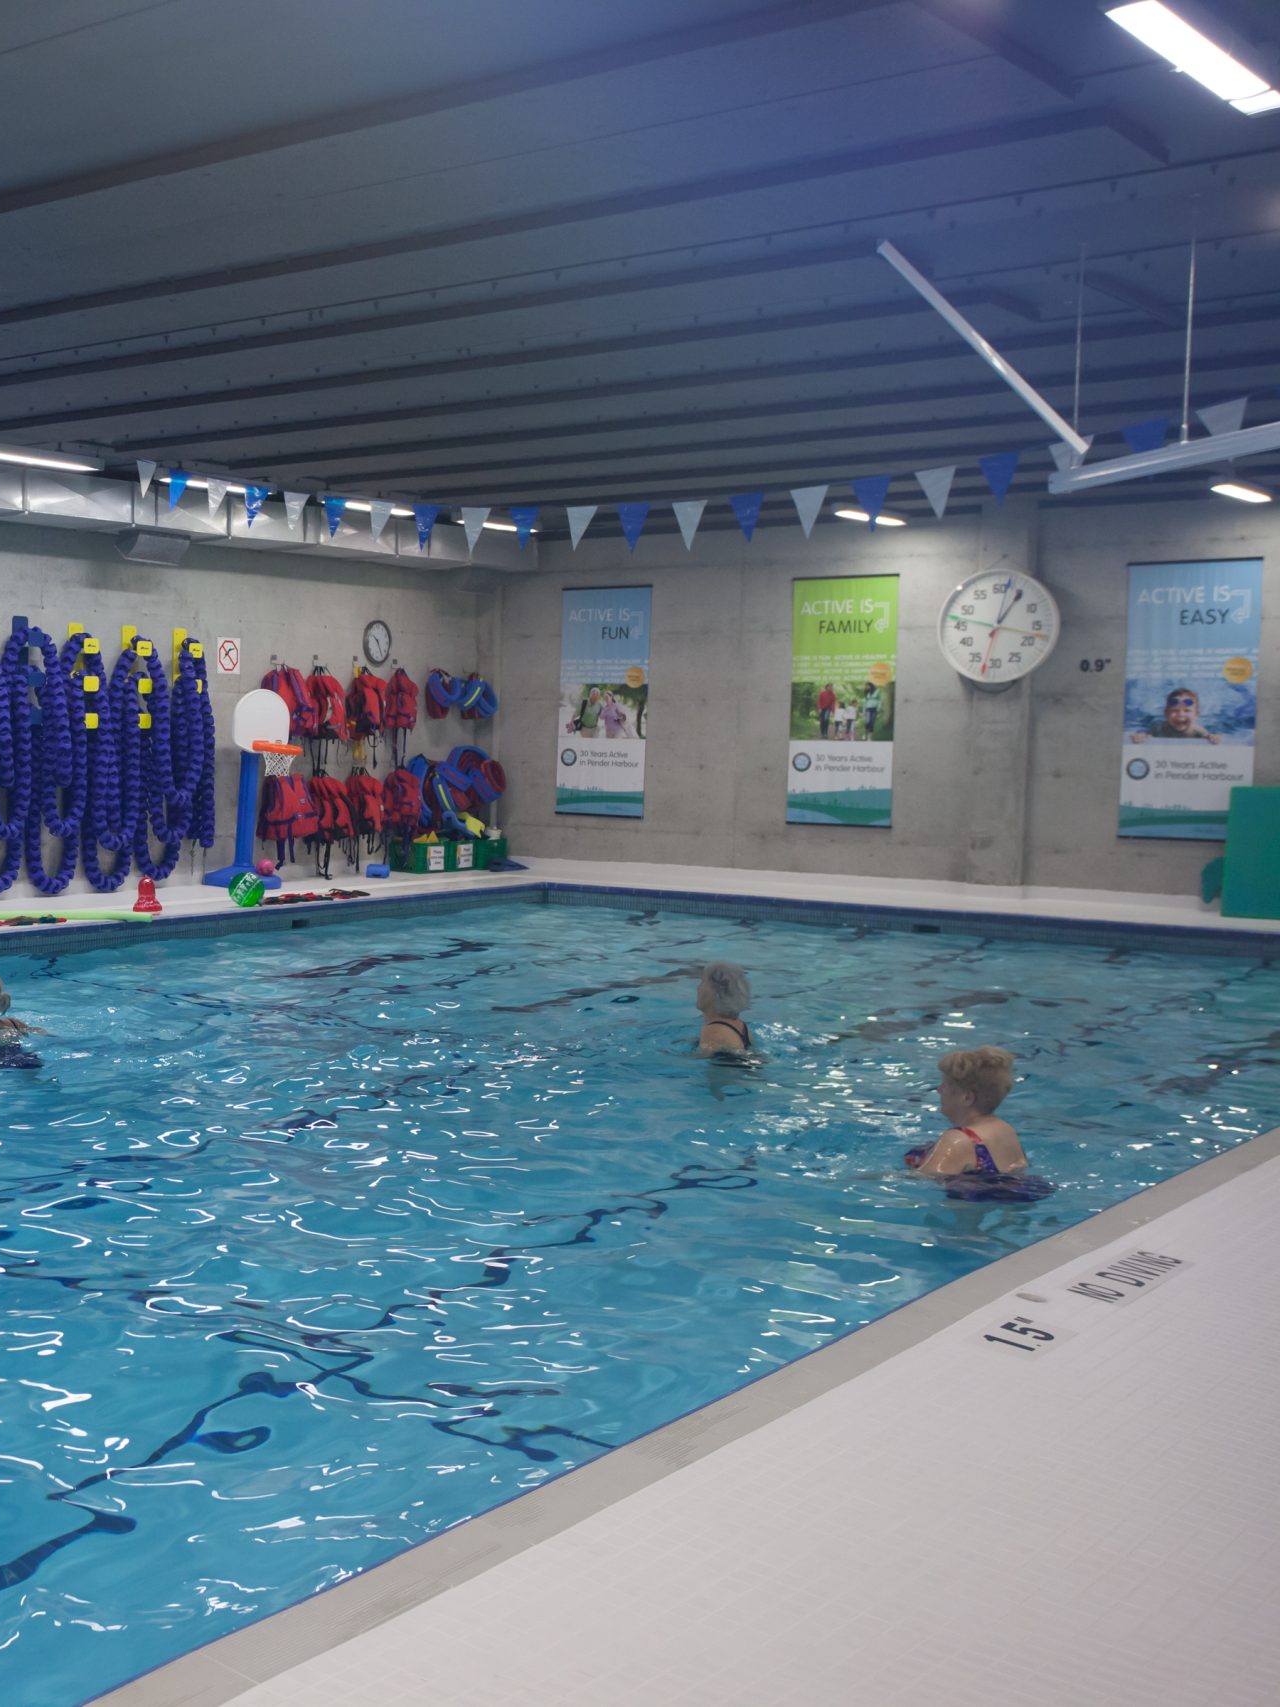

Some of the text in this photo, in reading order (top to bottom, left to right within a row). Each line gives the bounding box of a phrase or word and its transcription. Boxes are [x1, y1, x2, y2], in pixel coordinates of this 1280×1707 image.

[993, 583, 1008, 594] 60
[973, 590, 987, 600] 55
[1137, 585, 1231, 605] ACTIVE IS
[800, 598, 874, 616] ACTIVE IS
[961, 605, 975, 615] 50
[1026, 603, 1037, 614] 10
[569, 607, 631, 622] ACTIVE IS
[1179, 608, 1230, 625] EASY
[819, 619, 874, 634] FAMILY
[954, 621, 968, 631] 45
[1032, 620, 1042, 631] 15
[601, 626, 629, 640] FUN
[959, 636, 973, 647] 40
[1020, 636, 1035, 647] 20
[969, 652, 982, 663] 35
[1008, 652, 1021, 663] 25
[988, 658, 1002, 669] 30
[590, 750, 608, 758] Years
[815, 753, 873, 763] 30 Years Active
[587, 759, 610, 767] Pender
[611, 760, 639, 768] Harbour
[823, 764, 851, 772] Pender
[852, 765, 885, 773] Harbour
[1154, 760, 1228, 770] 30 Years Active
[1154, 771, 1244, 781] in Pender Harbour
[1066, 1251, 1184, 1304] NO DIVING
